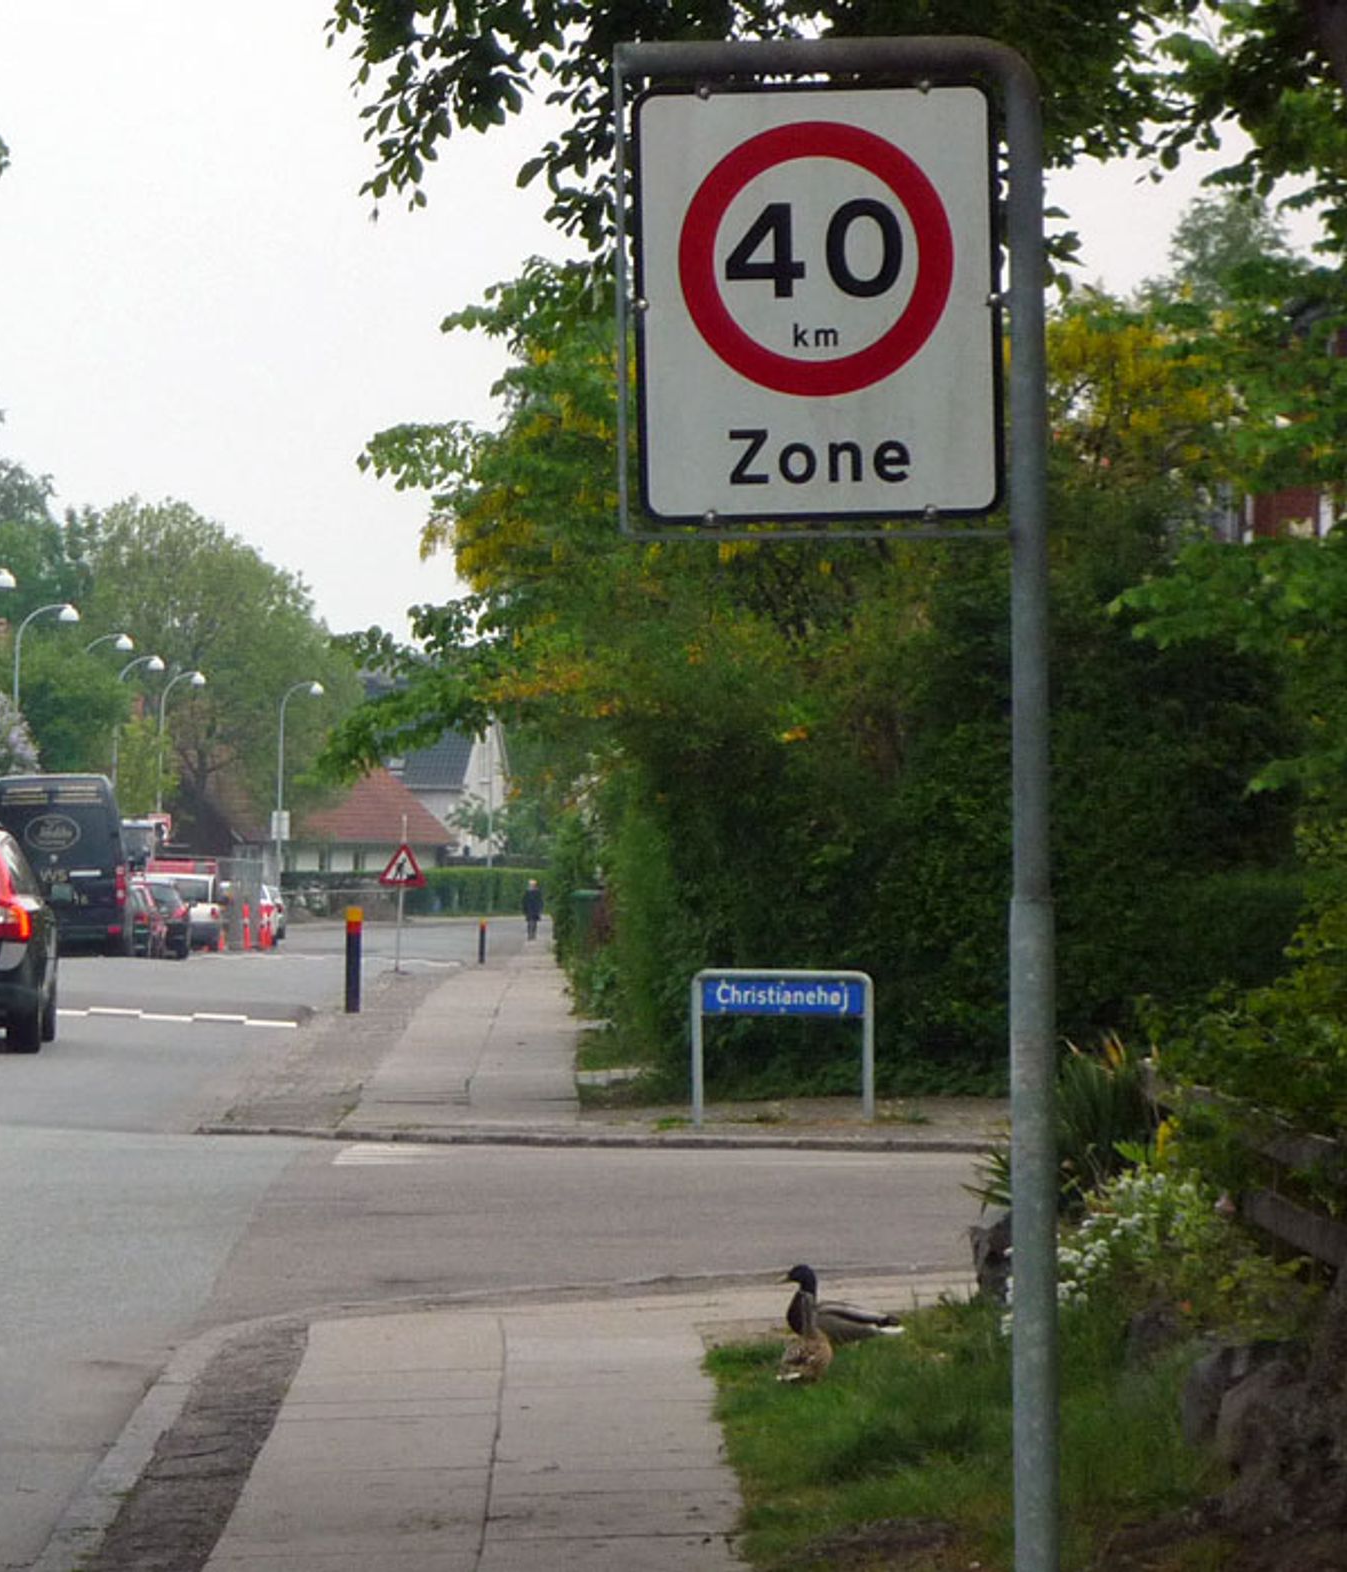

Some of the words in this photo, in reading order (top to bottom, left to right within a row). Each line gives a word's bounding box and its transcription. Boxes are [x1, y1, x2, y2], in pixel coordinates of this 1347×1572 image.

[724, 197, 904, 299] 40
[792, 323, 839, 348] km
[728, 429, 911, 485] Zone
